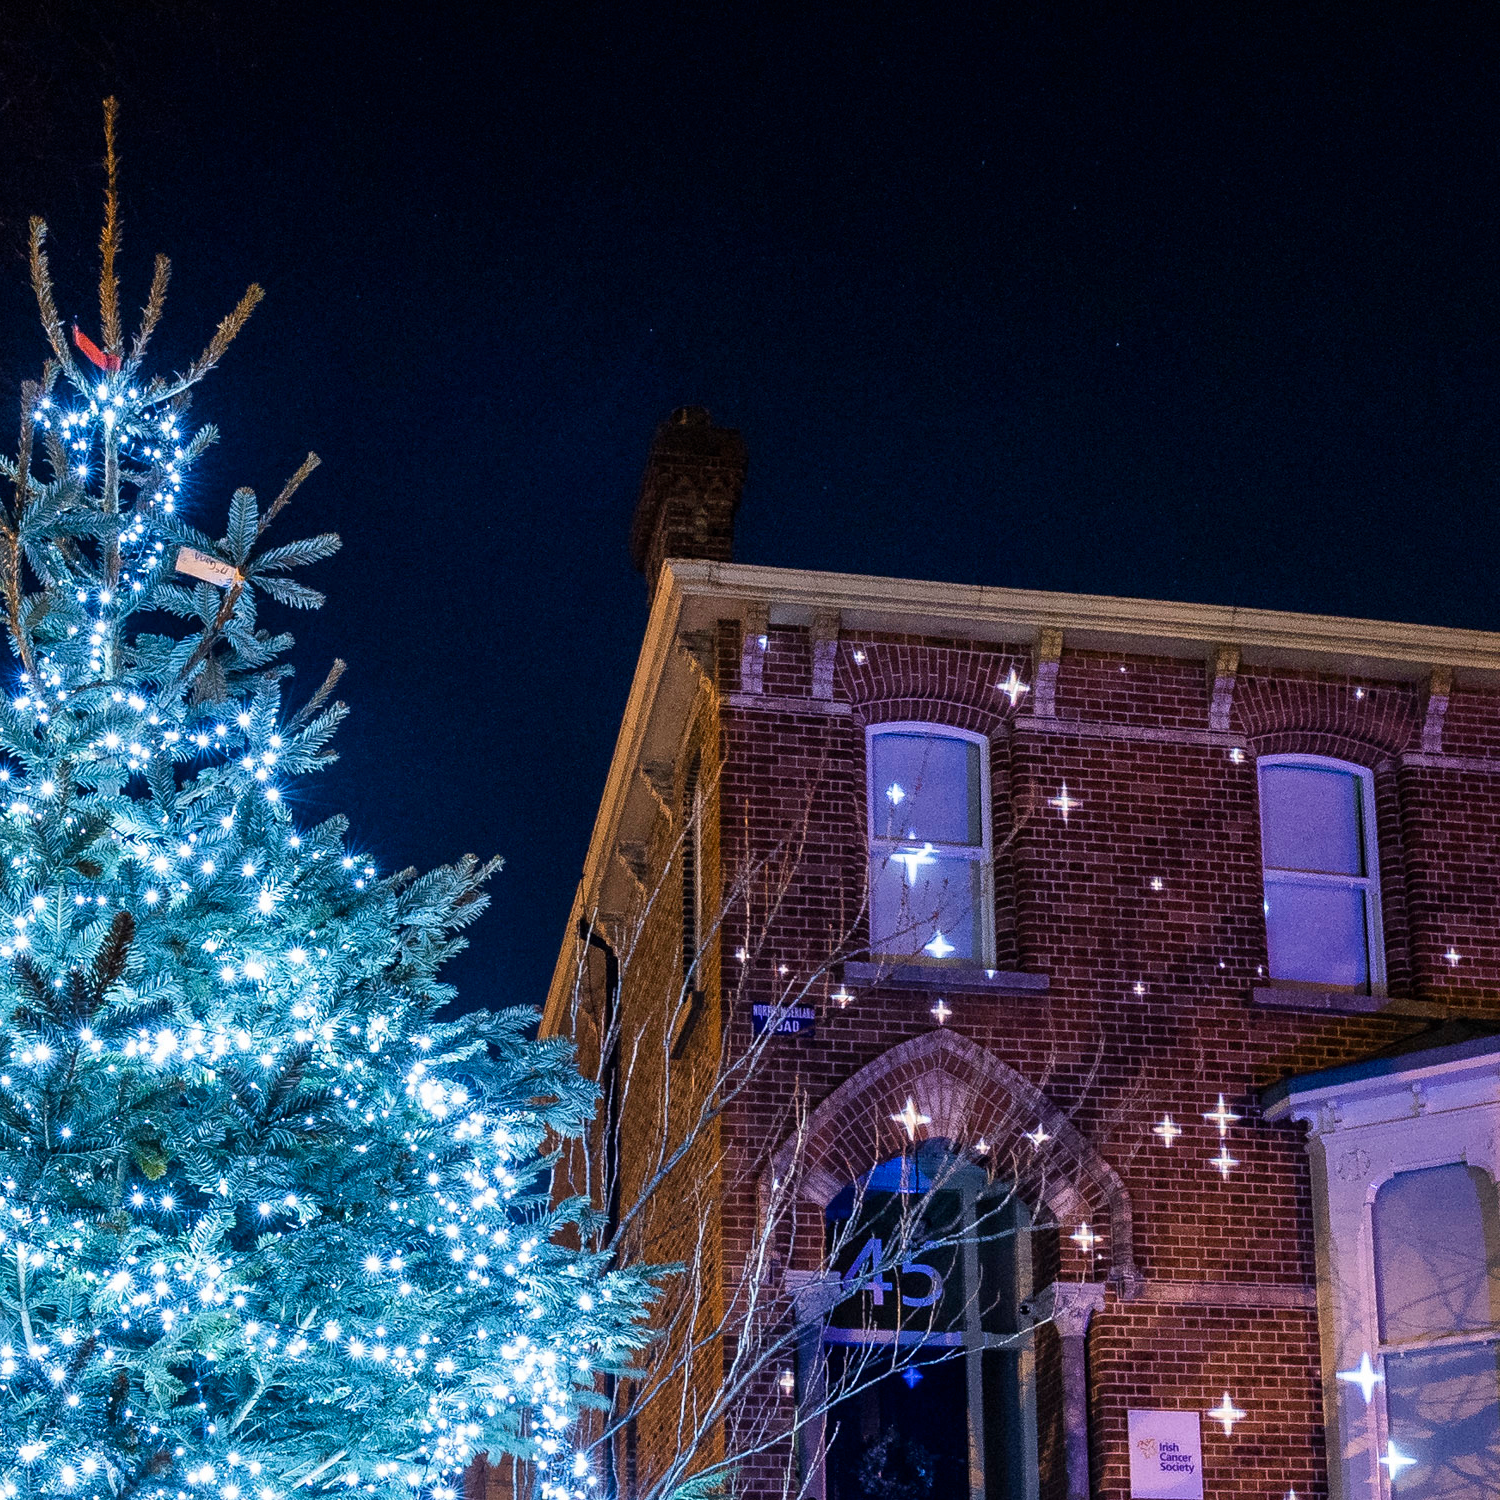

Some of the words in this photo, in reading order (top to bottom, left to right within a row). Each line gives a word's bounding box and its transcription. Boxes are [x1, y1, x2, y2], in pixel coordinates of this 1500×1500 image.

[842, 1238, 942, 1307] 45
[1159, 1442, 1179, 1452] Irish
[1160, 1452, 1192, 1462] Cancer
[1160, 1462, 1194, 1474] Society
